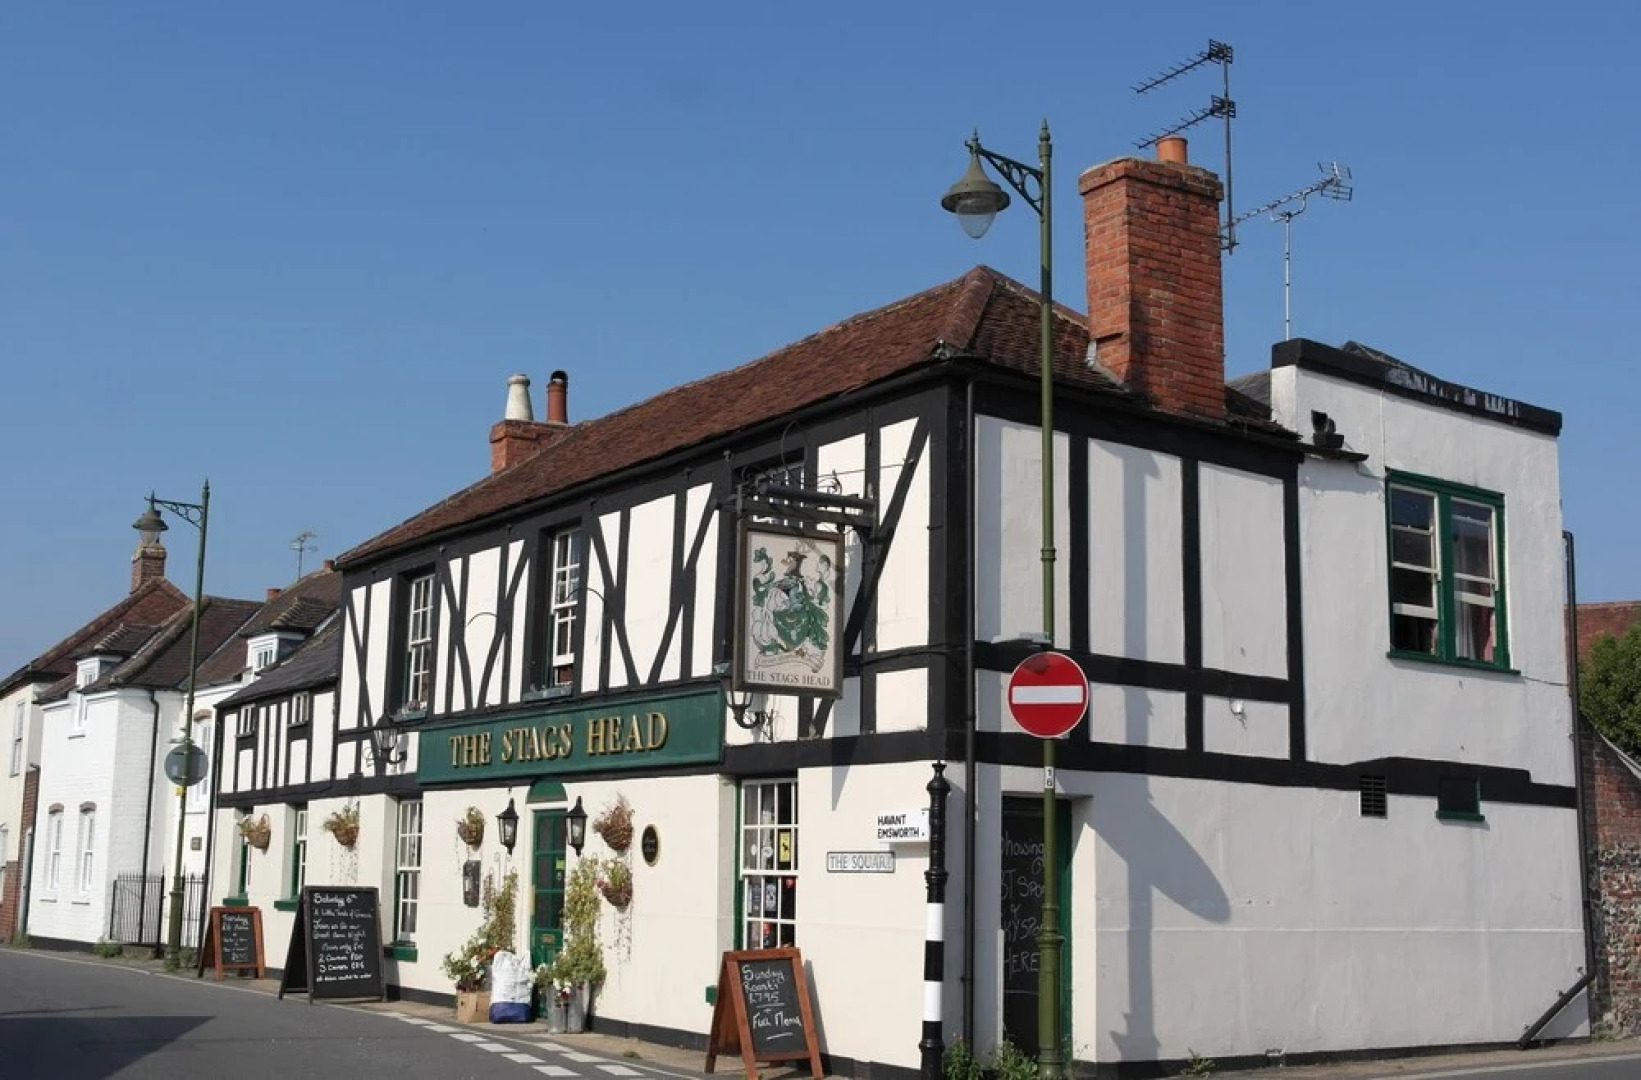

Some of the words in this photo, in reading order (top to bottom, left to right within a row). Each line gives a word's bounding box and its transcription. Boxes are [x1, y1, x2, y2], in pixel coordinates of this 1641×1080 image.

[747, 671, 766, 682] THE
[770, 672, 799, 684] STAGS
[801, 675, 831, 686] HEAD
[449, 731, 492, 768] THE
[501, 723, 573, 763] STAGS
[586, 712, 669, 756] HEAD
[878, 814, 906, 826] HAVANT
[878, 826, 920, 839] EMSWORTH
[830, 855, 848, 869] THE
[852, 854, 893, 869] SQUARE
[742, 964, 785, 983] Sunday
[753, 1012, 771, 1029] Full
[774, 1010, 803, 1027] Menu
